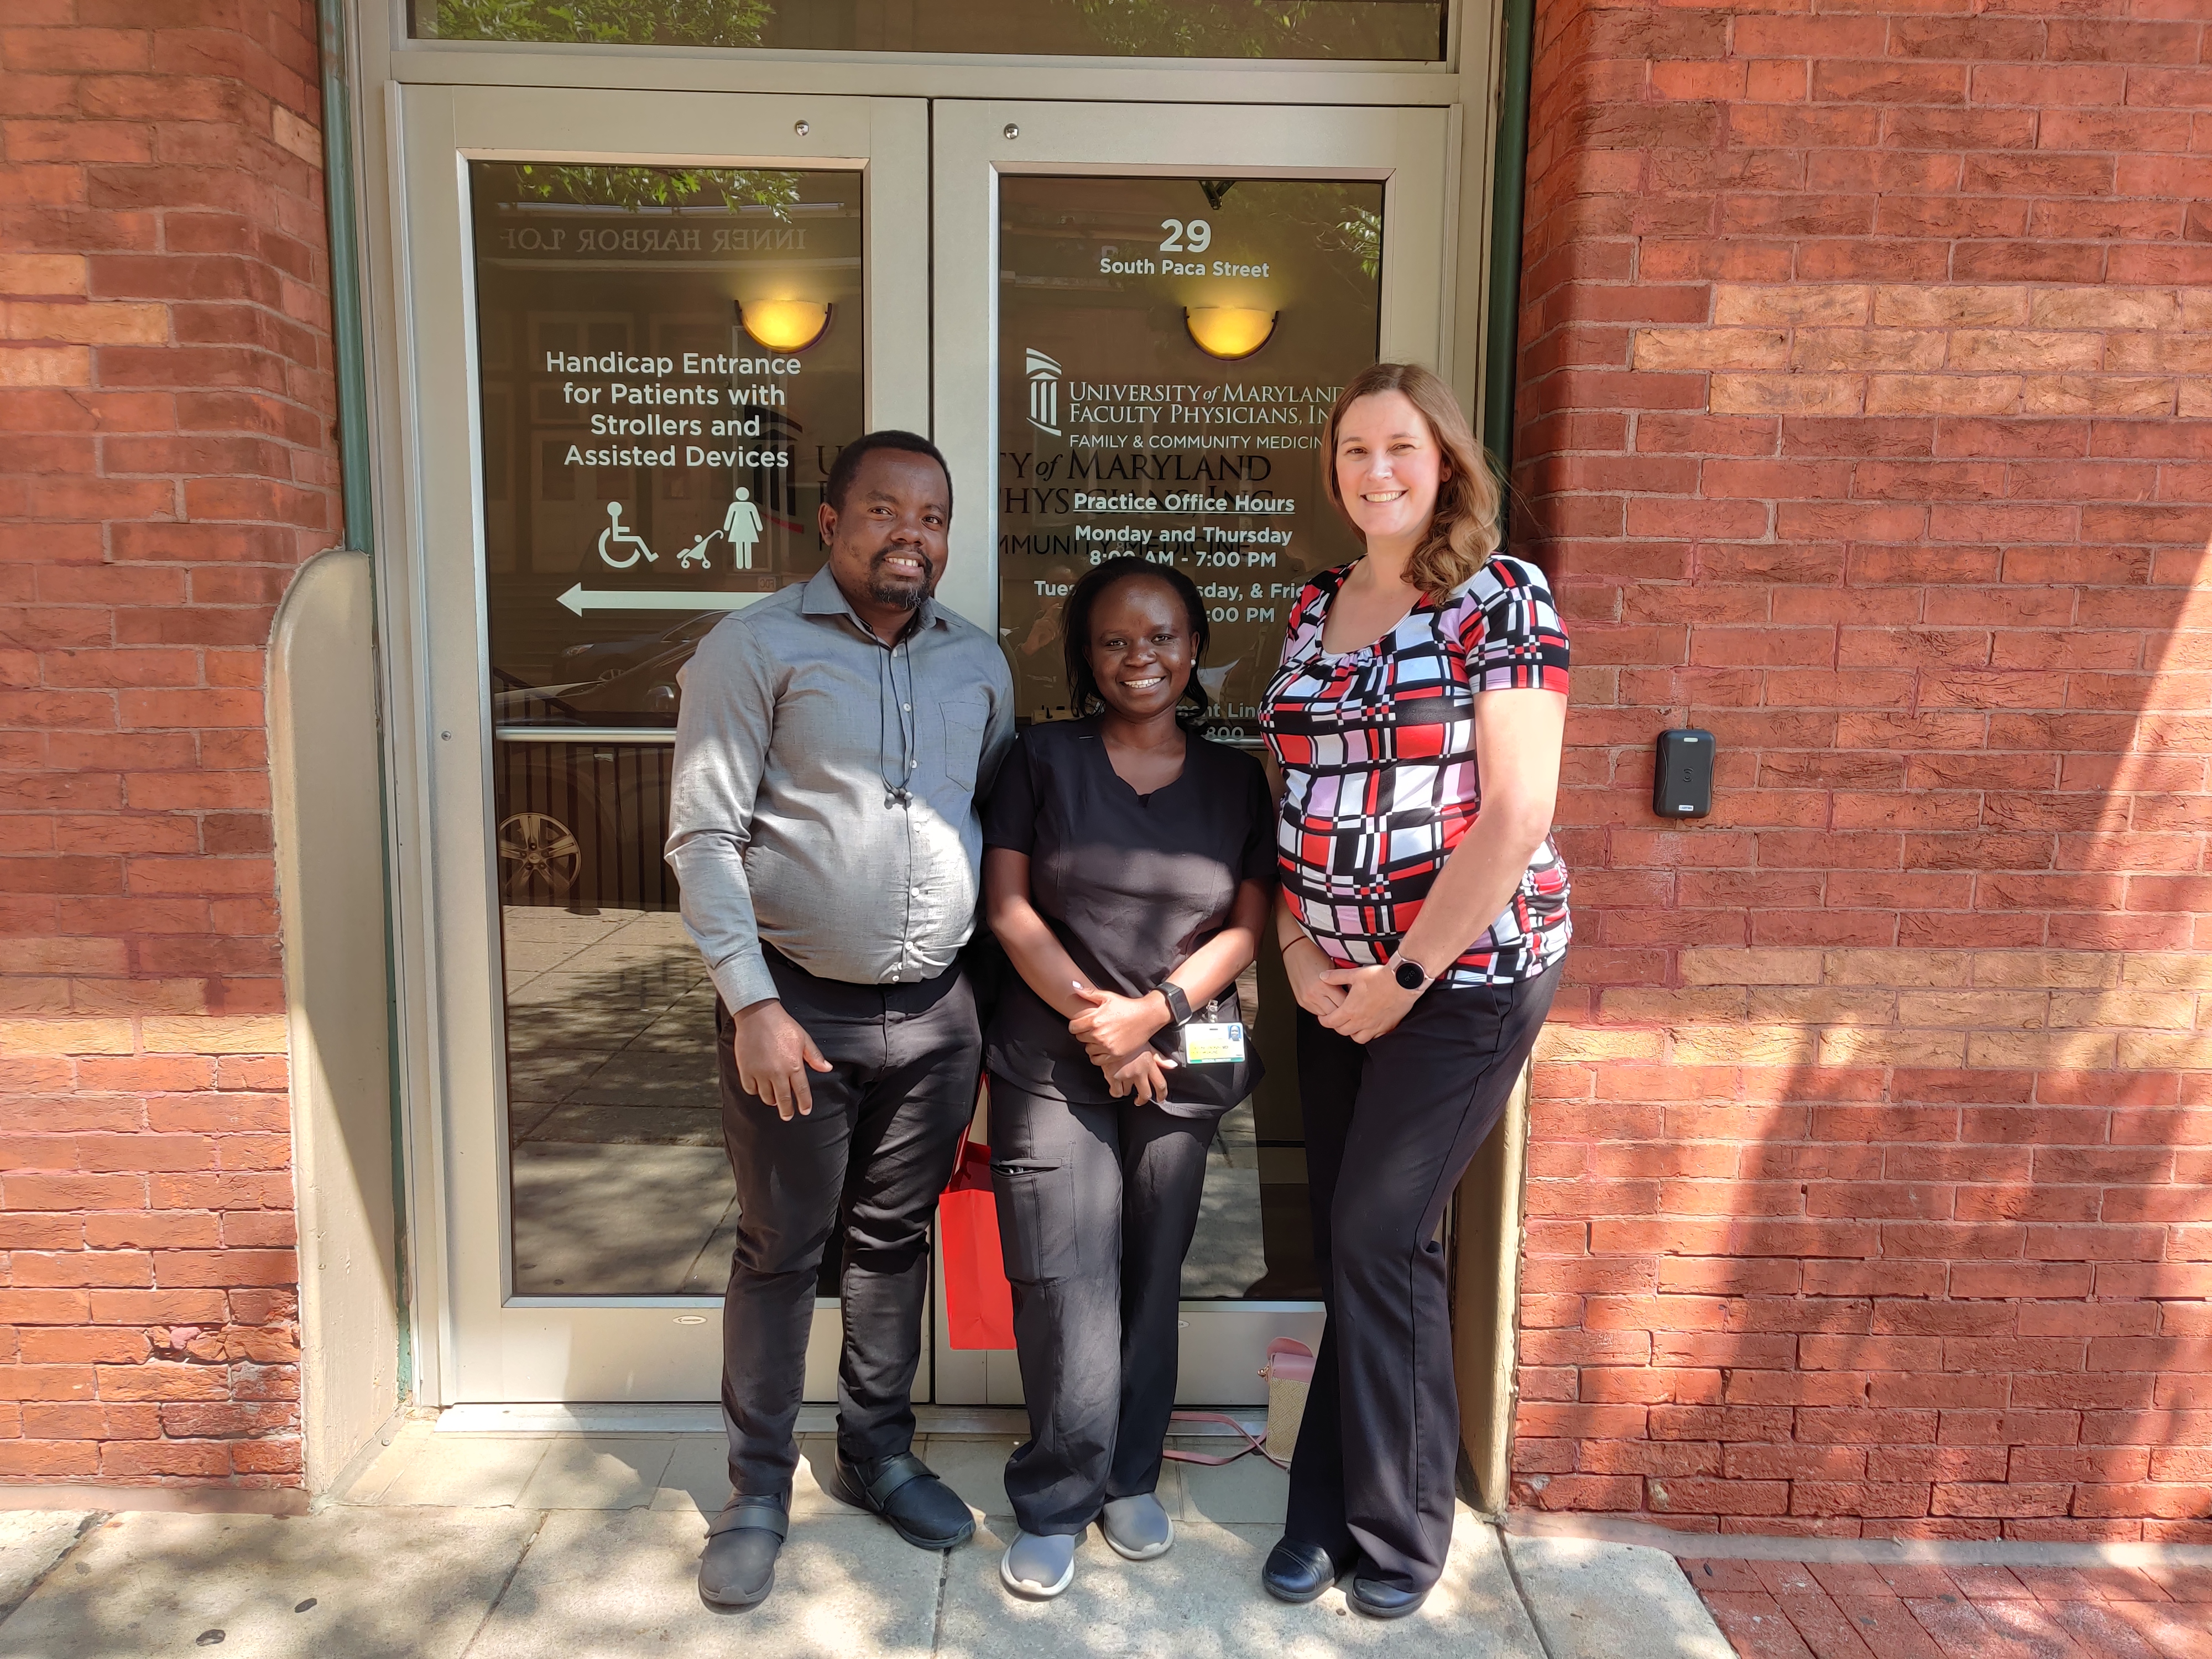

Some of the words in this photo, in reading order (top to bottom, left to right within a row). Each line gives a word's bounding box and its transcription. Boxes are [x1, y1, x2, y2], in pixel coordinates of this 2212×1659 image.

[1160, 218, 1211, 253] 29
[1100, 258, 1155, 274] South
[1162, 259, 1206, 275] Paca
[1212, 260, 1269, 278] Street
[546, 351, 673, 378] Handicap
[683, 353, 801, 374] Entrance
[563, 382, 602, 404] for
[611, 383, 719, 405] Patients
[728, 384, 785, 405] with
[1070, 382, 1201, 401] UNIVERSITY
[1203, 386, 1218, 404] of
[1070, 403, 1162, 423] FACULTY
[1171, 404, 1302, 425] PHYSICIANS,
[1310, 405, 1328, 424] IN
[591, 414, 702, 436] Strollers
[711, 415, 760, 436] and
[1070, 435, 1128, 448] FAMILY
[1133, 435, 1144, 448] &
[1149, 435, 1251, 448] COMMUNITY
[1257, 436, 1322, 448] MEDICIN
[564, 445, 676, 466] Assisted
[686, 446, 789, 468] Devices
[1036, 455, 1063, 481] of
[1067, 449, 1272, 482] MARYLAND
[1073, 493, 1157, 510] Practice
[1164, 493, 1228, 511] Office
[1235, 494, 1295, 512] Hours
[1076, 525, 1152, 545] Monday
[1159, 526, 1196, 542] and
[1203, 526, 1293, 546] Thursday
[1145, 551, 1173, 566] AM
[1196, 551, 1240, 567] 7:00
[1248, 551, 1276, 567] PM
[1034, 580, 1077, 596] Tues
[1250, 583, 1263, 598] &
[1206, 607, 1239, 622] :00
[1246, 607, 1275, 622] PM
[1228, 702, 1256, 718] Lin
